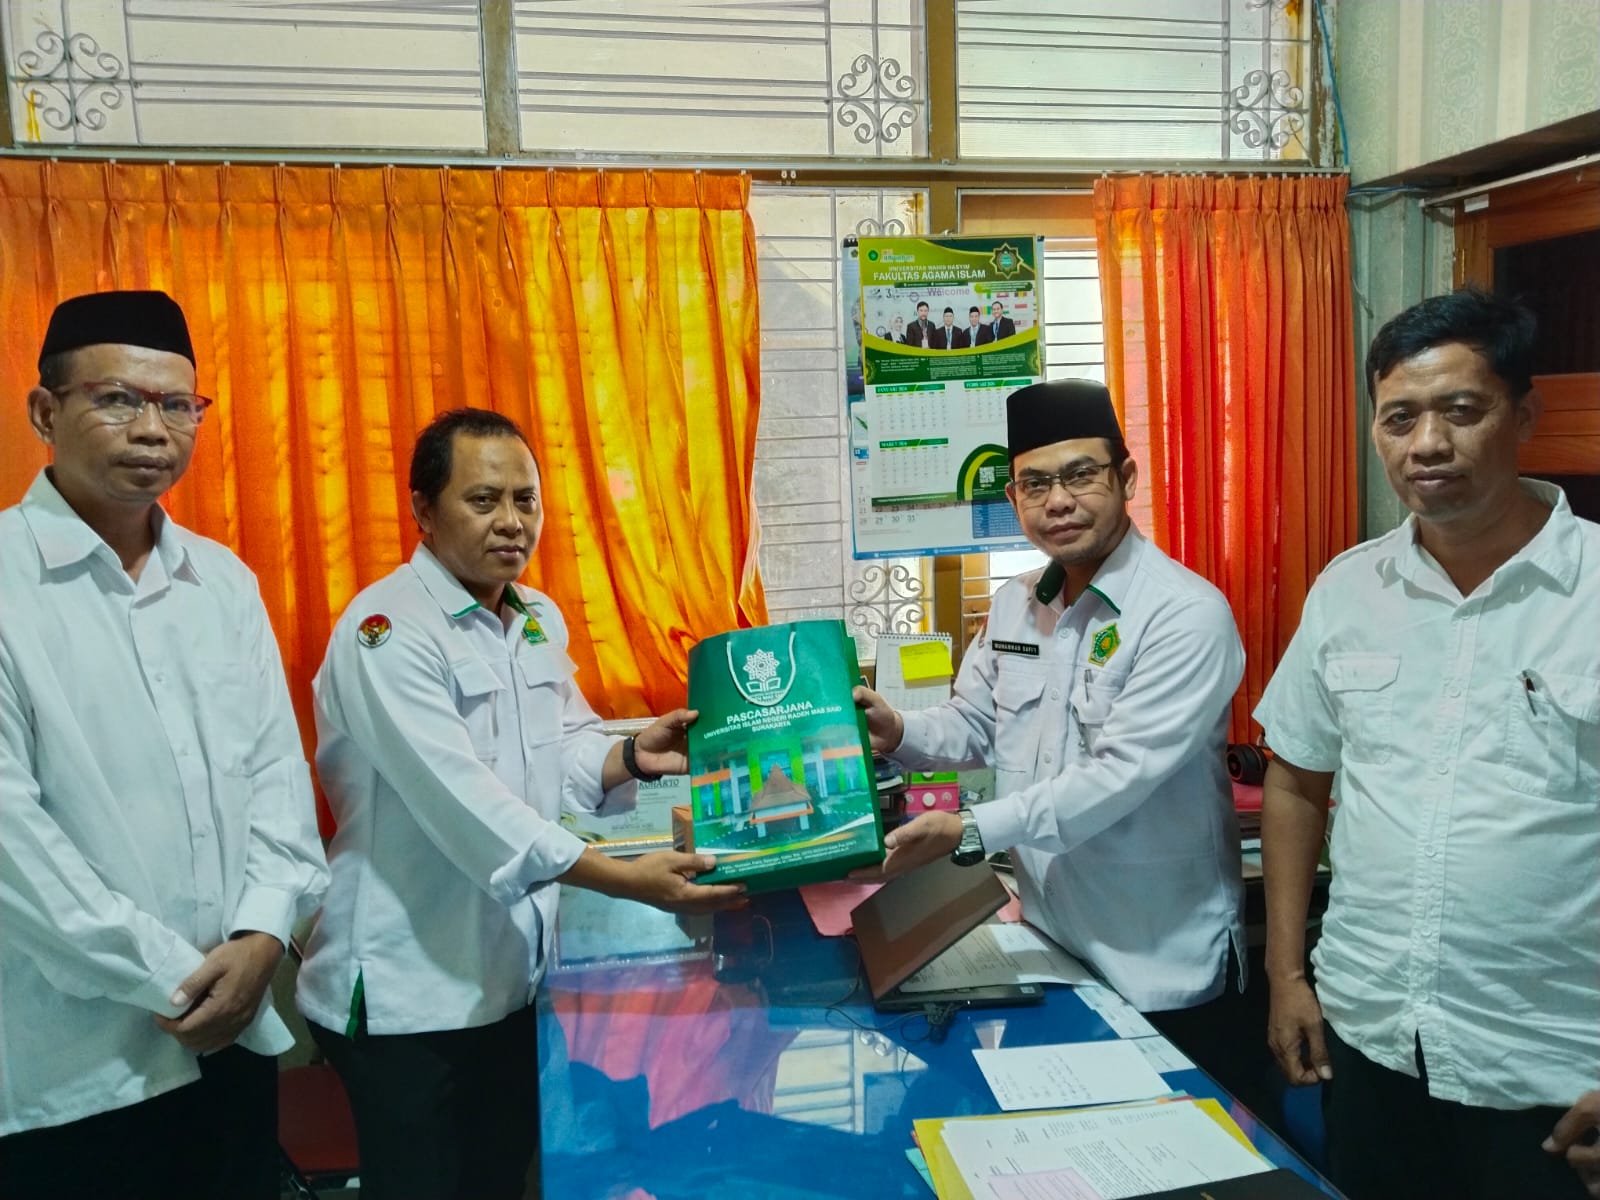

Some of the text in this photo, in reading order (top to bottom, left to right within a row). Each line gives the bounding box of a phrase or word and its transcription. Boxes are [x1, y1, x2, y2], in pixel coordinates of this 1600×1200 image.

[873, 269, 986, 281] FAKULTAS AGAMA ISLAM
[927, 287, 970, 297] Welcome
[726, 701, 813, 725] PASCASARJANA
[704, 724, 742, 740] UNIVERSITAS
[742, 719, 762, 729] ISLAM
[762, 714, 787, 724] NEGERI
